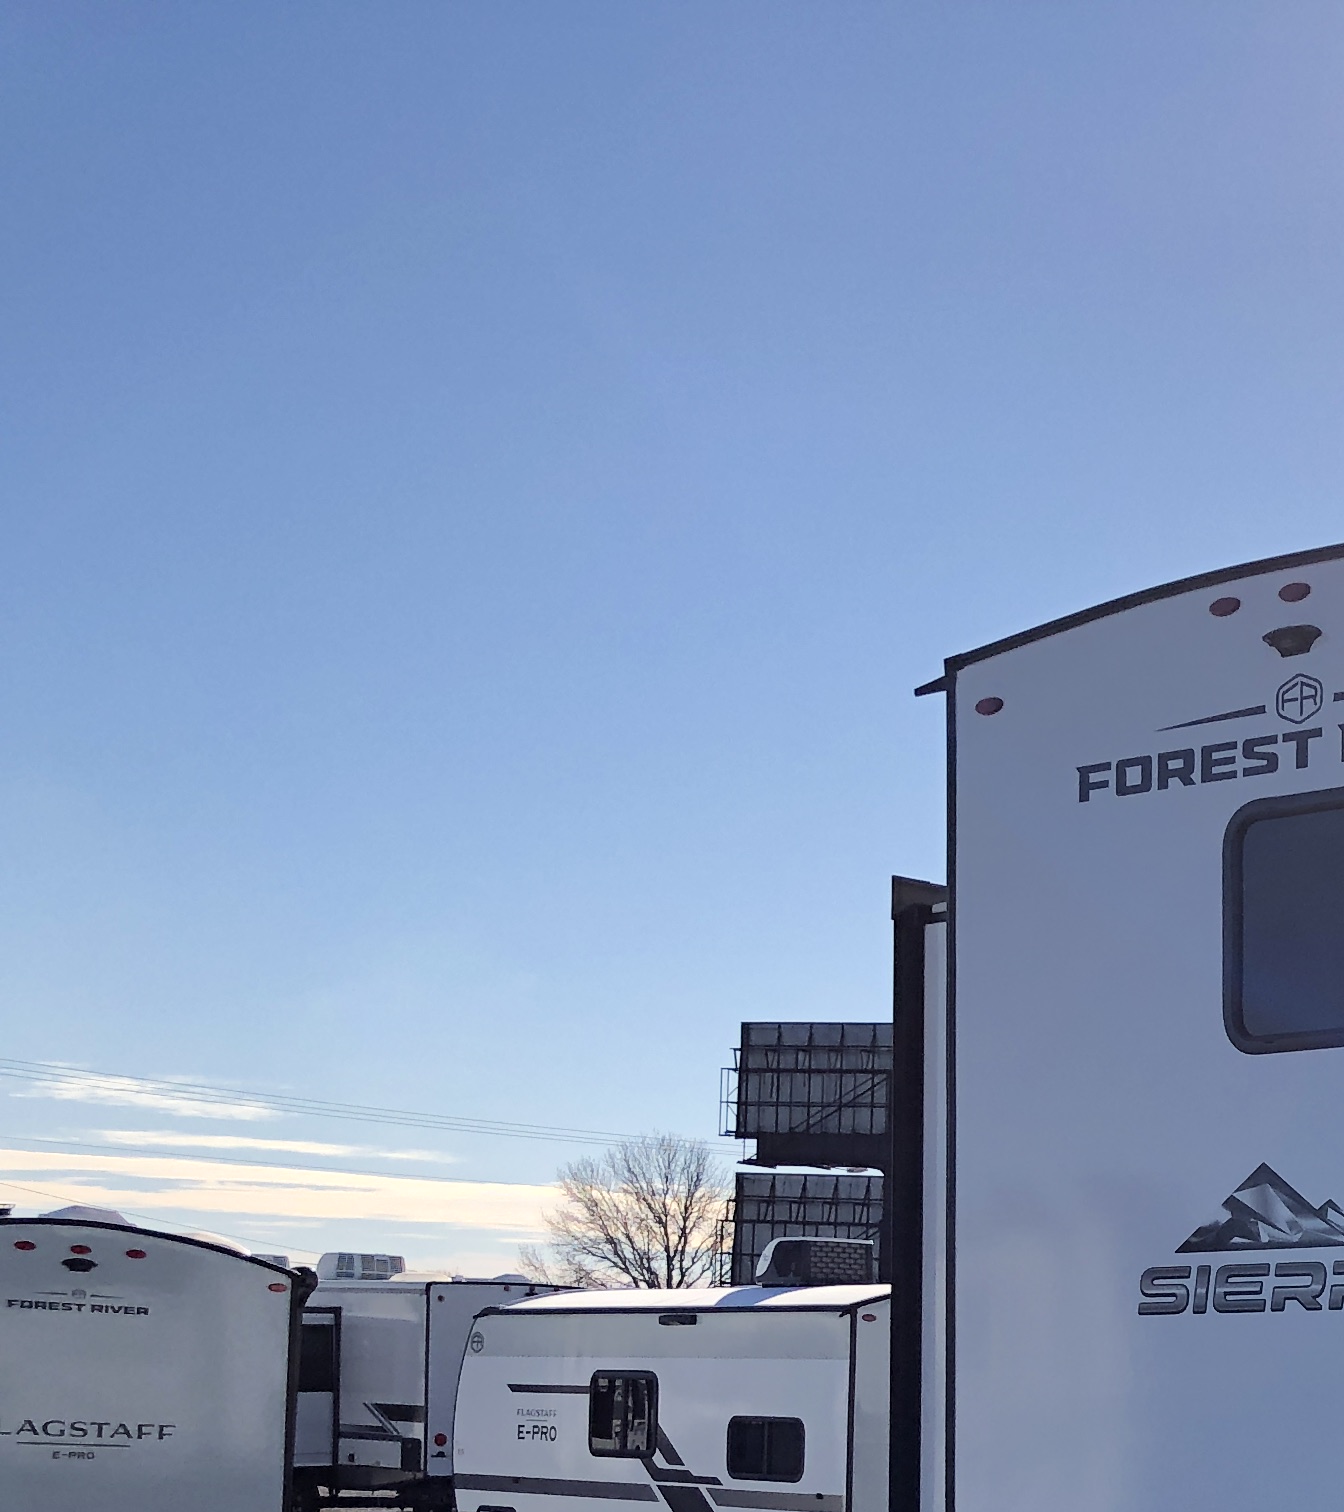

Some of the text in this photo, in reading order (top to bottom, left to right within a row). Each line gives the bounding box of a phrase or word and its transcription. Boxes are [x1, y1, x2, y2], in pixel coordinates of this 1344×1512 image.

[1076, 726, 1323, 803] FOREST
[7, 1299, 150, 1316] FOREST RIVER
[516, 1408, 557, 1418] FLAGSTAFF
[517, 1424, 558, 1442] E-PRO
[52, 1450, 96, 1461] E-PRO
